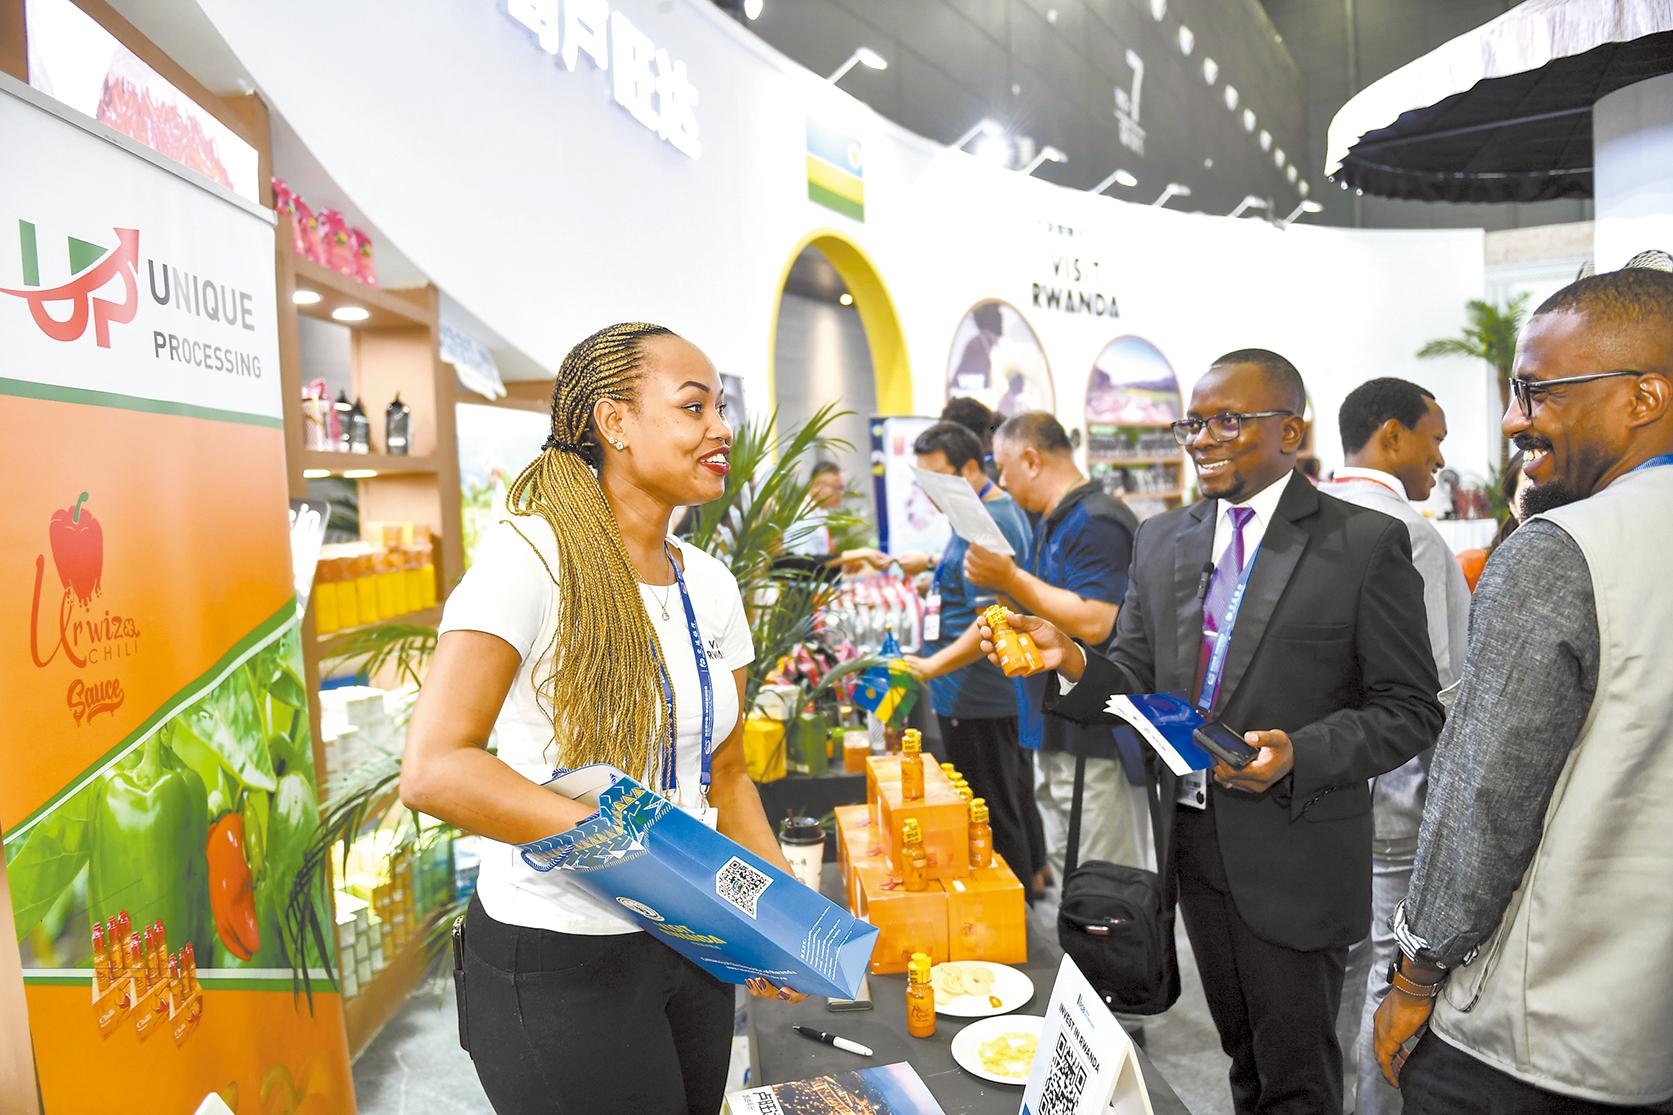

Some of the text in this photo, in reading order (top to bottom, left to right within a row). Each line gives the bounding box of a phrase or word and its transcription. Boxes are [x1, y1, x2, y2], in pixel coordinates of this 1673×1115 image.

[148, 259, 255, 332] UNIQUE
[1032, 282, 1120, 318] RWANDA
[153, 330, 262, 379] PROCESSING
[88, 641, 138, 664] CHILI
[66, 678, 125, 726] Sauce
[1058, 1002, 1075, 1031] INVEST
[1073, 1026, 1081, 1041] IN
[1079, 1035, 1101, 1075] RWANDA
